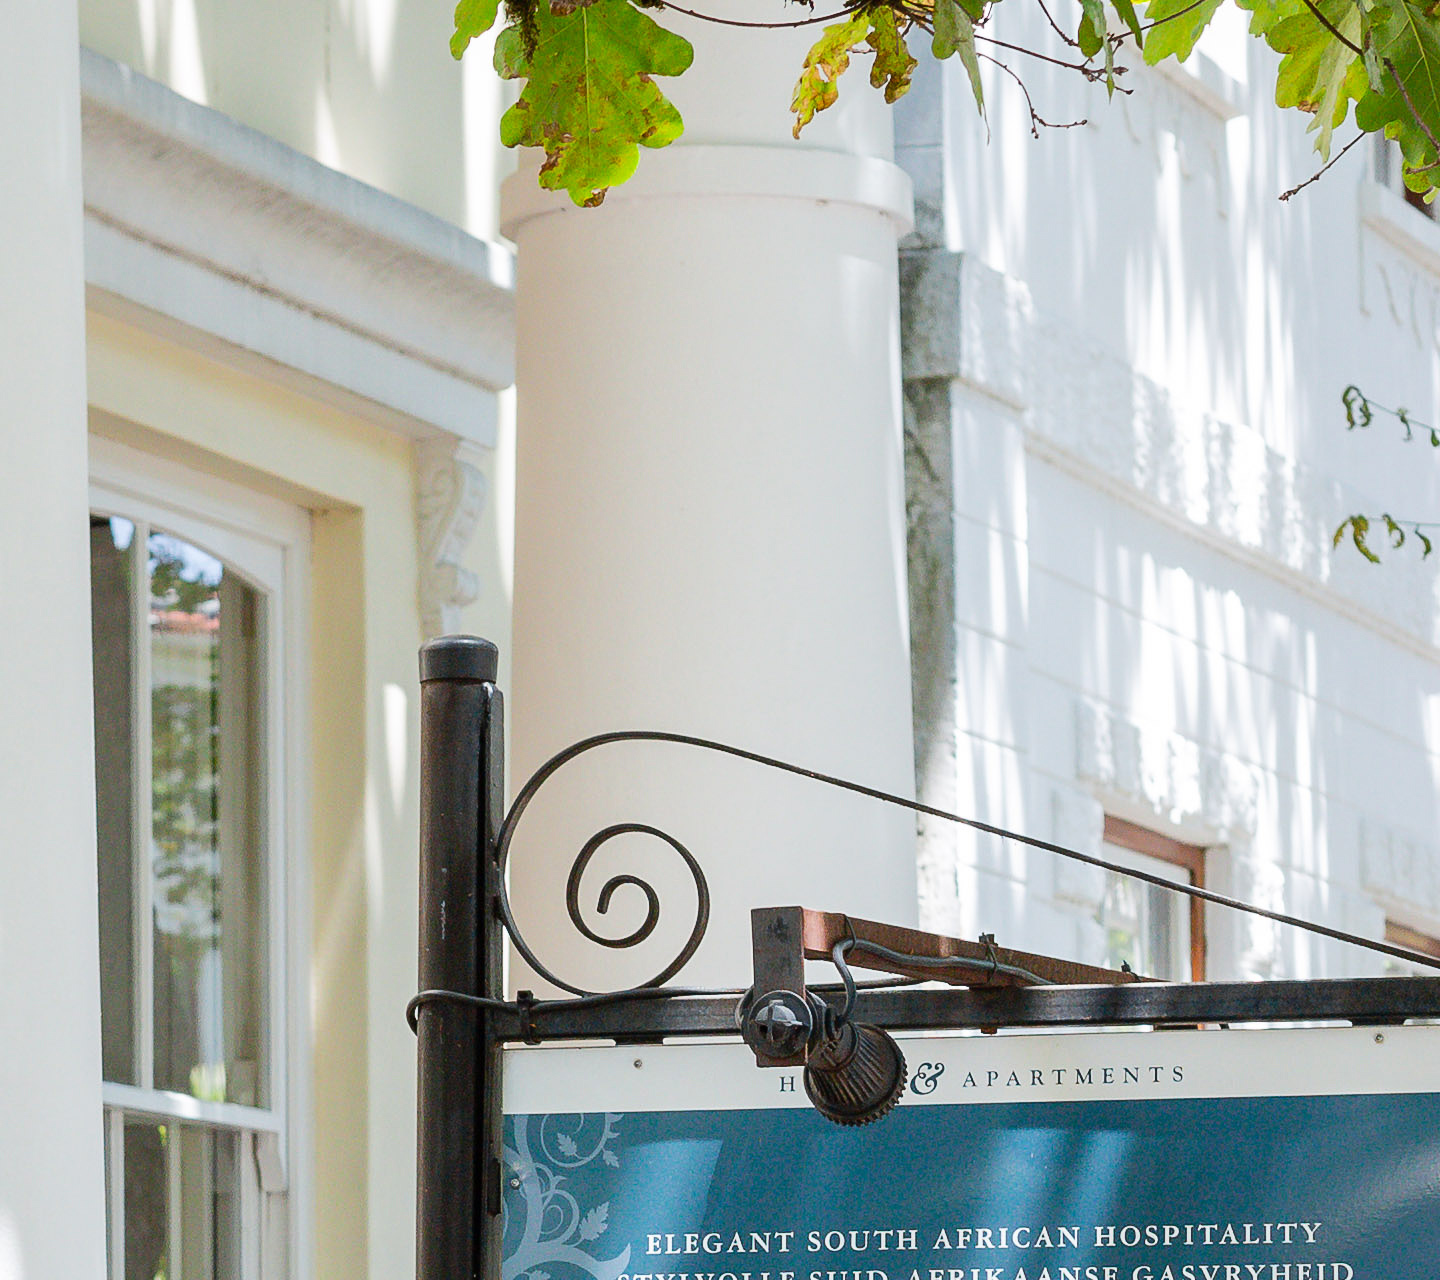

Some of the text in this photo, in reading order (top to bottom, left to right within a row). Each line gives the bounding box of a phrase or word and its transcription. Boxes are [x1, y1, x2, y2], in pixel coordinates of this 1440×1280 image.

[910, 1063, 1182, 1095] & APARTMENTS
[646, 1223, 1321, 1255] ELEGANT SOUTH AFRICAN HOSPITALITY
